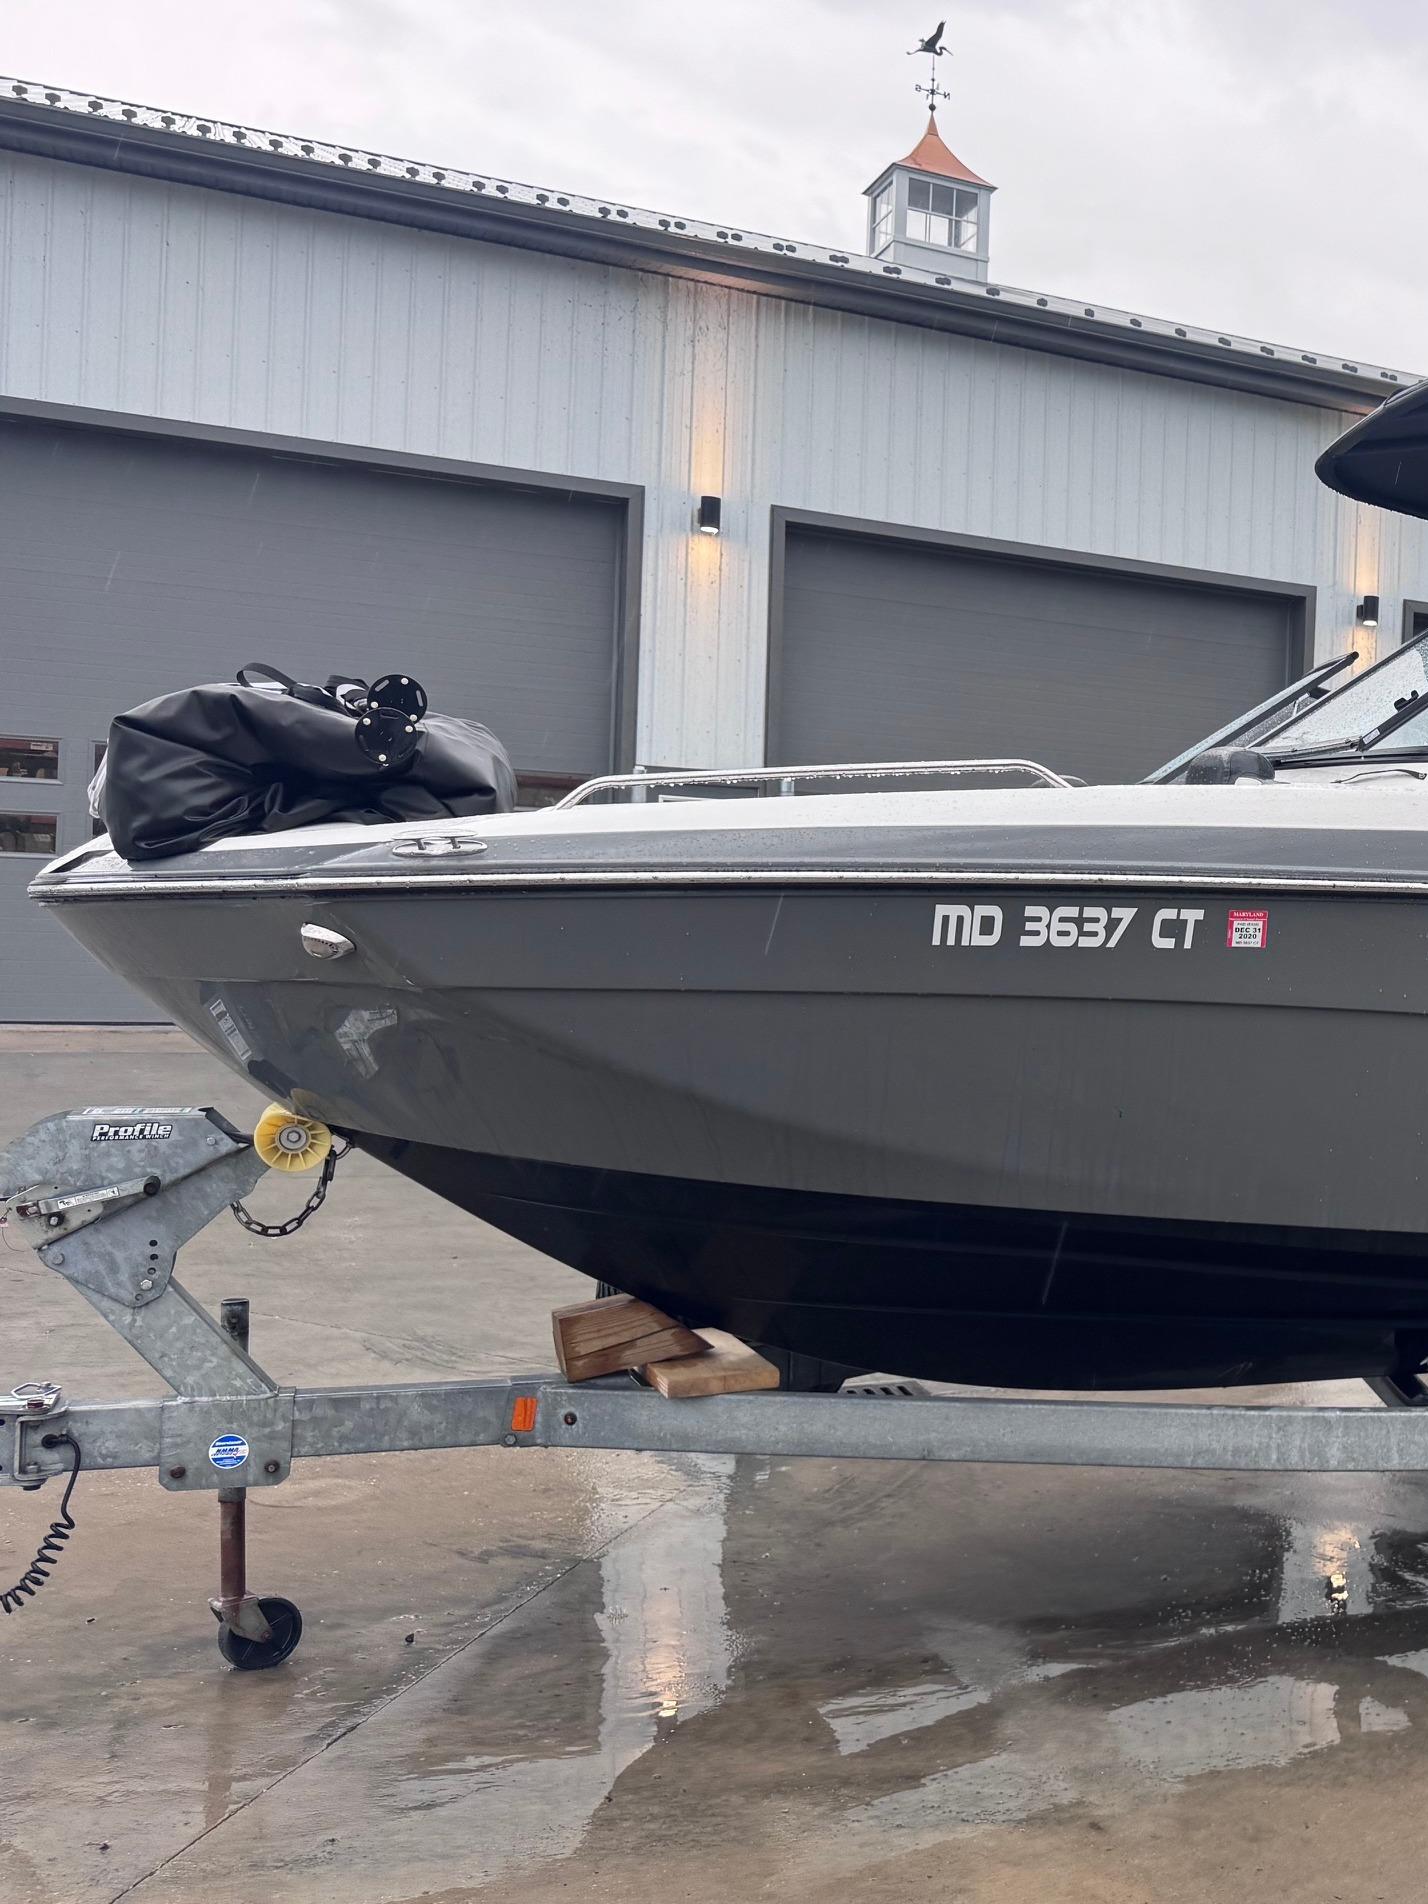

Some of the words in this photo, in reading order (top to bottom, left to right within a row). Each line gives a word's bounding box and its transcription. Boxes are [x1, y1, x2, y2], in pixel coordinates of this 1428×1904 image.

[932, 904, 1003, 946] MD
[1019, 905, 1139, 948] 3637
[1151, 908, 1205, 949] CT
[93, 1122, 172, 1137] Profile
